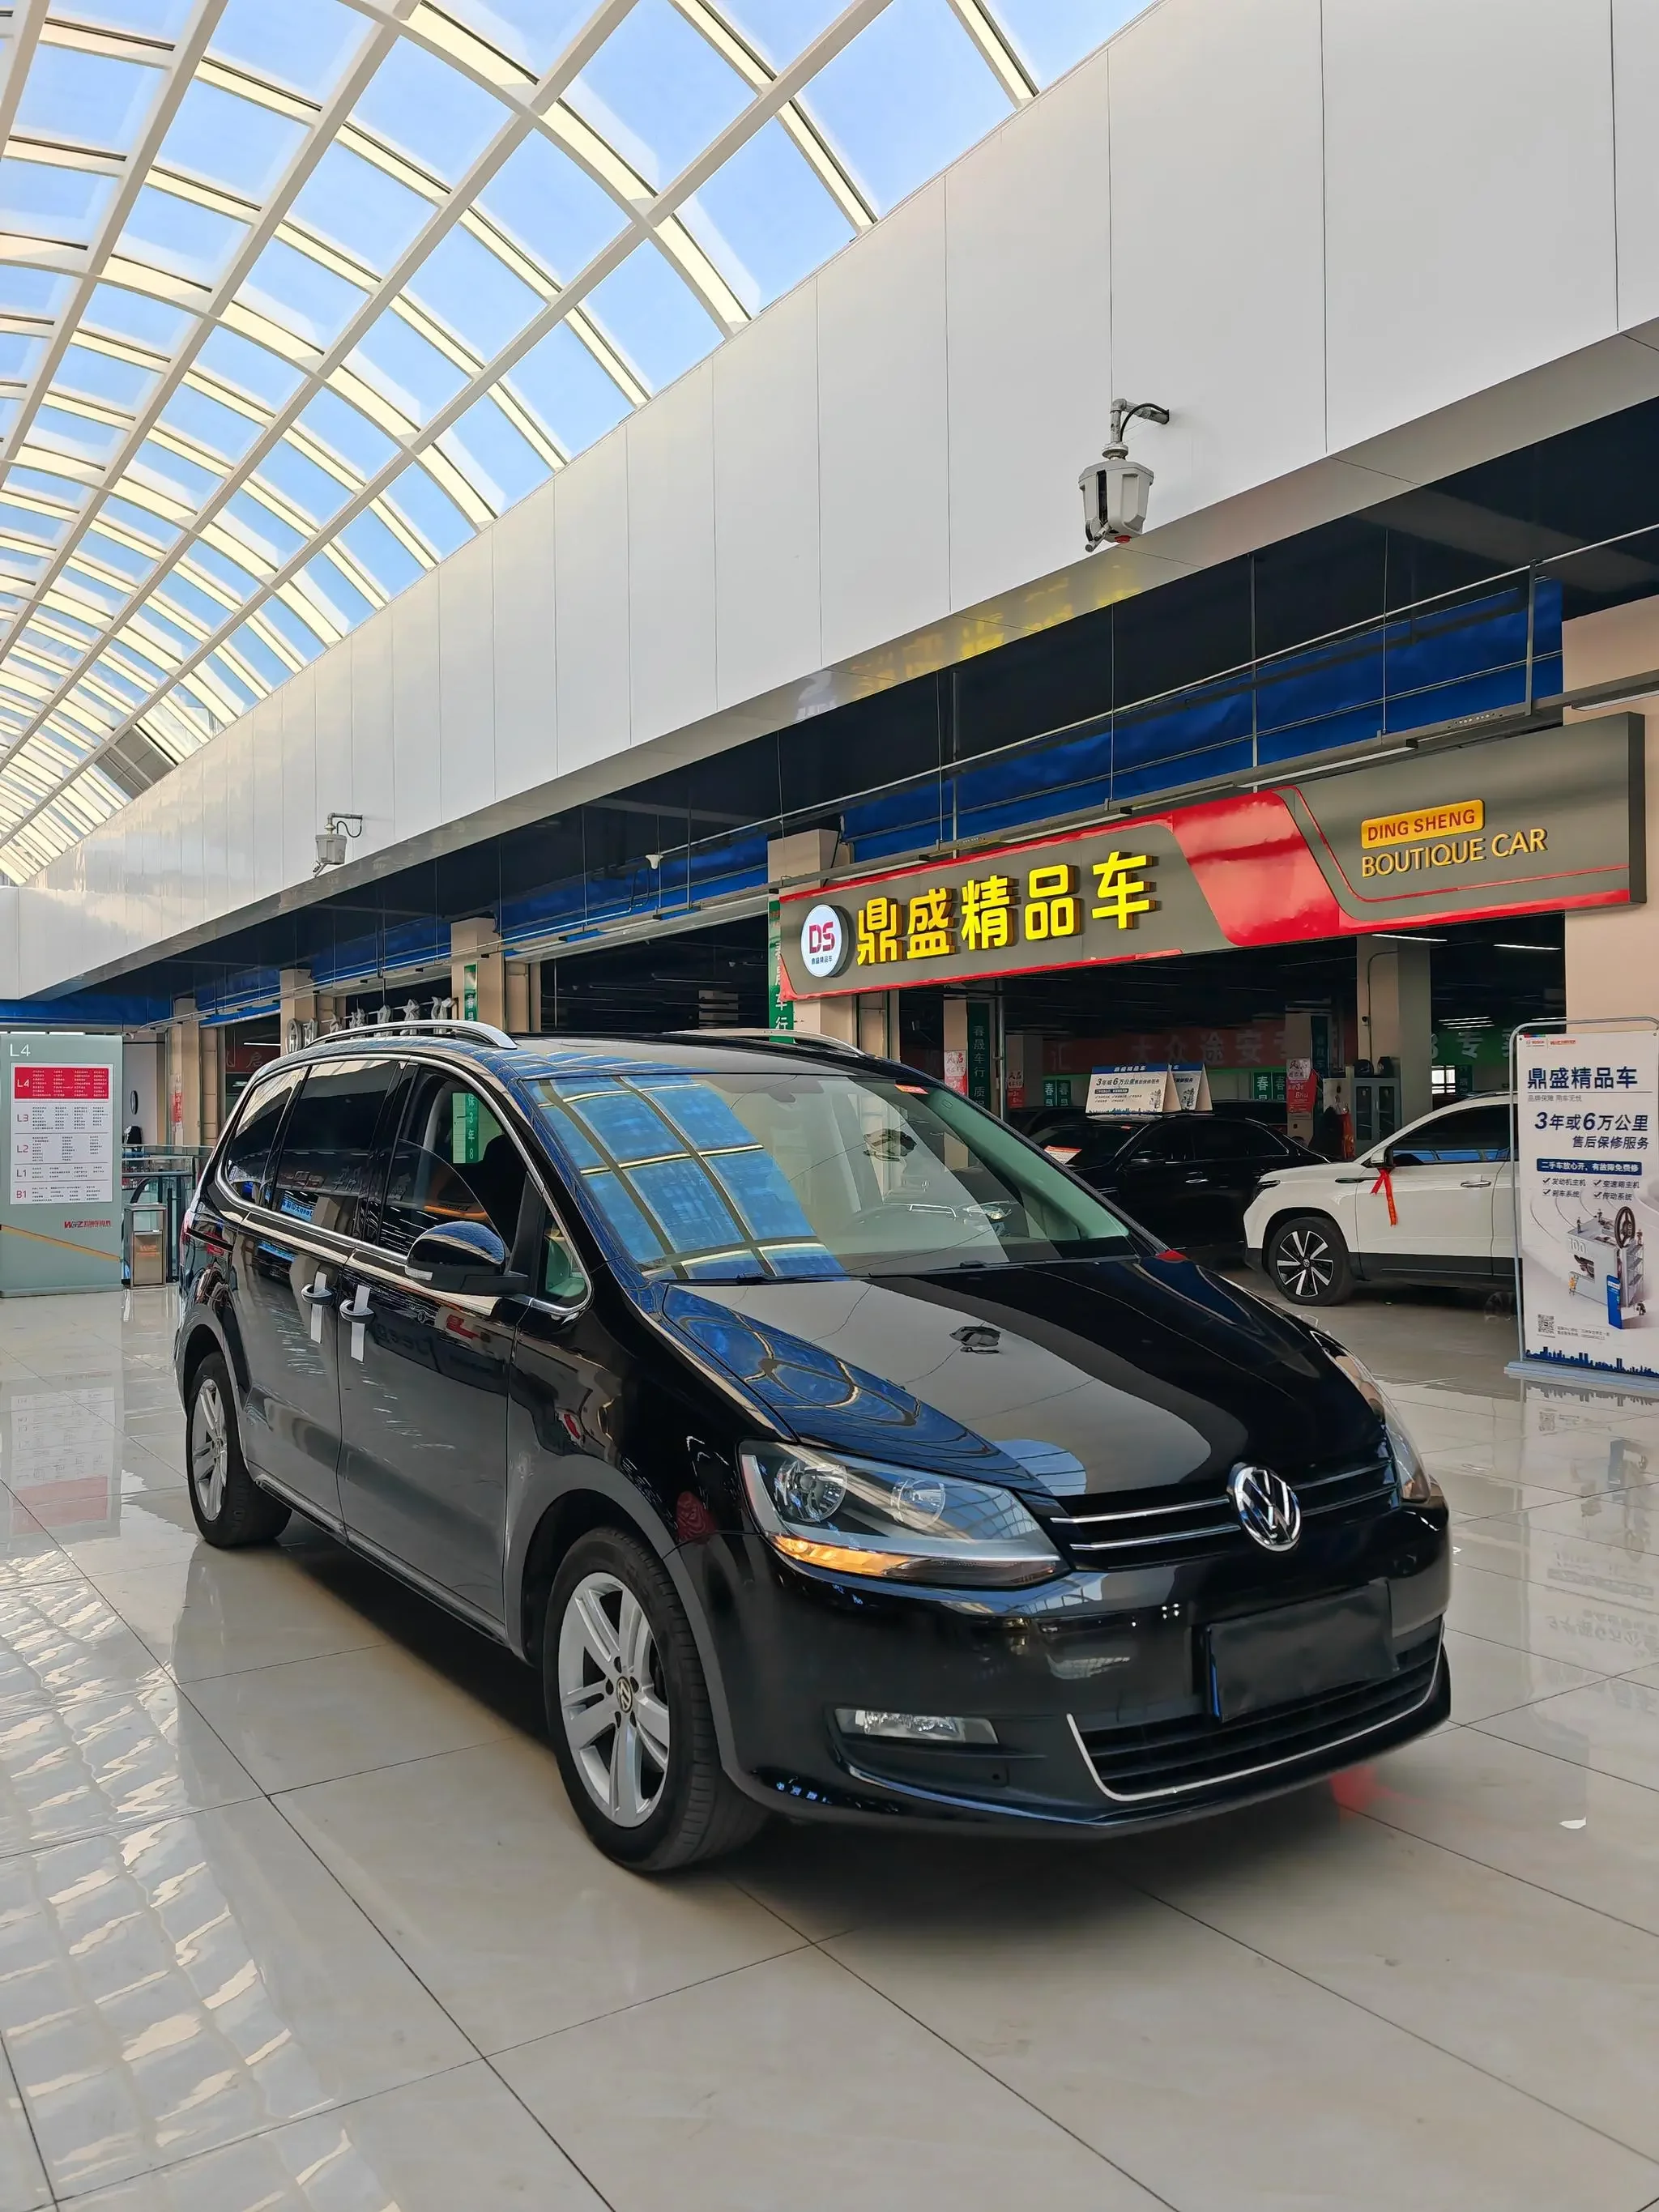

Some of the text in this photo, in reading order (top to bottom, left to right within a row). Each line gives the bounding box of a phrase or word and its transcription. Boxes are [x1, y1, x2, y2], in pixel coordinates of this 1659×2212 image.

[1367, 808, 1475, 842] DING SHENG
[1362, 828, 1548, 877] BOUTIQUE CAR
[856, 850, 1155, 966] 鼎盛精品车
[809, 922, 835, 953] DS
[10, 1043, 31, 1057] L4
[17, 1079, 29, 1088] L4
[1528, 1066, 1638, 1089] 鼎盛精品车
[17, 1114, 28, 1122] L3
[1534, 1111, 1648, 1132] 3年或6万公里
[16, 1144, 28, 1153] L2
[1572, 1136, 1649, 1150] 售后保修服务
[16, 1169, 27, 1177] L1
[1552, 1178, 1586, 1187] 发动机主机
[16, 1190, 27, 1199] B1
